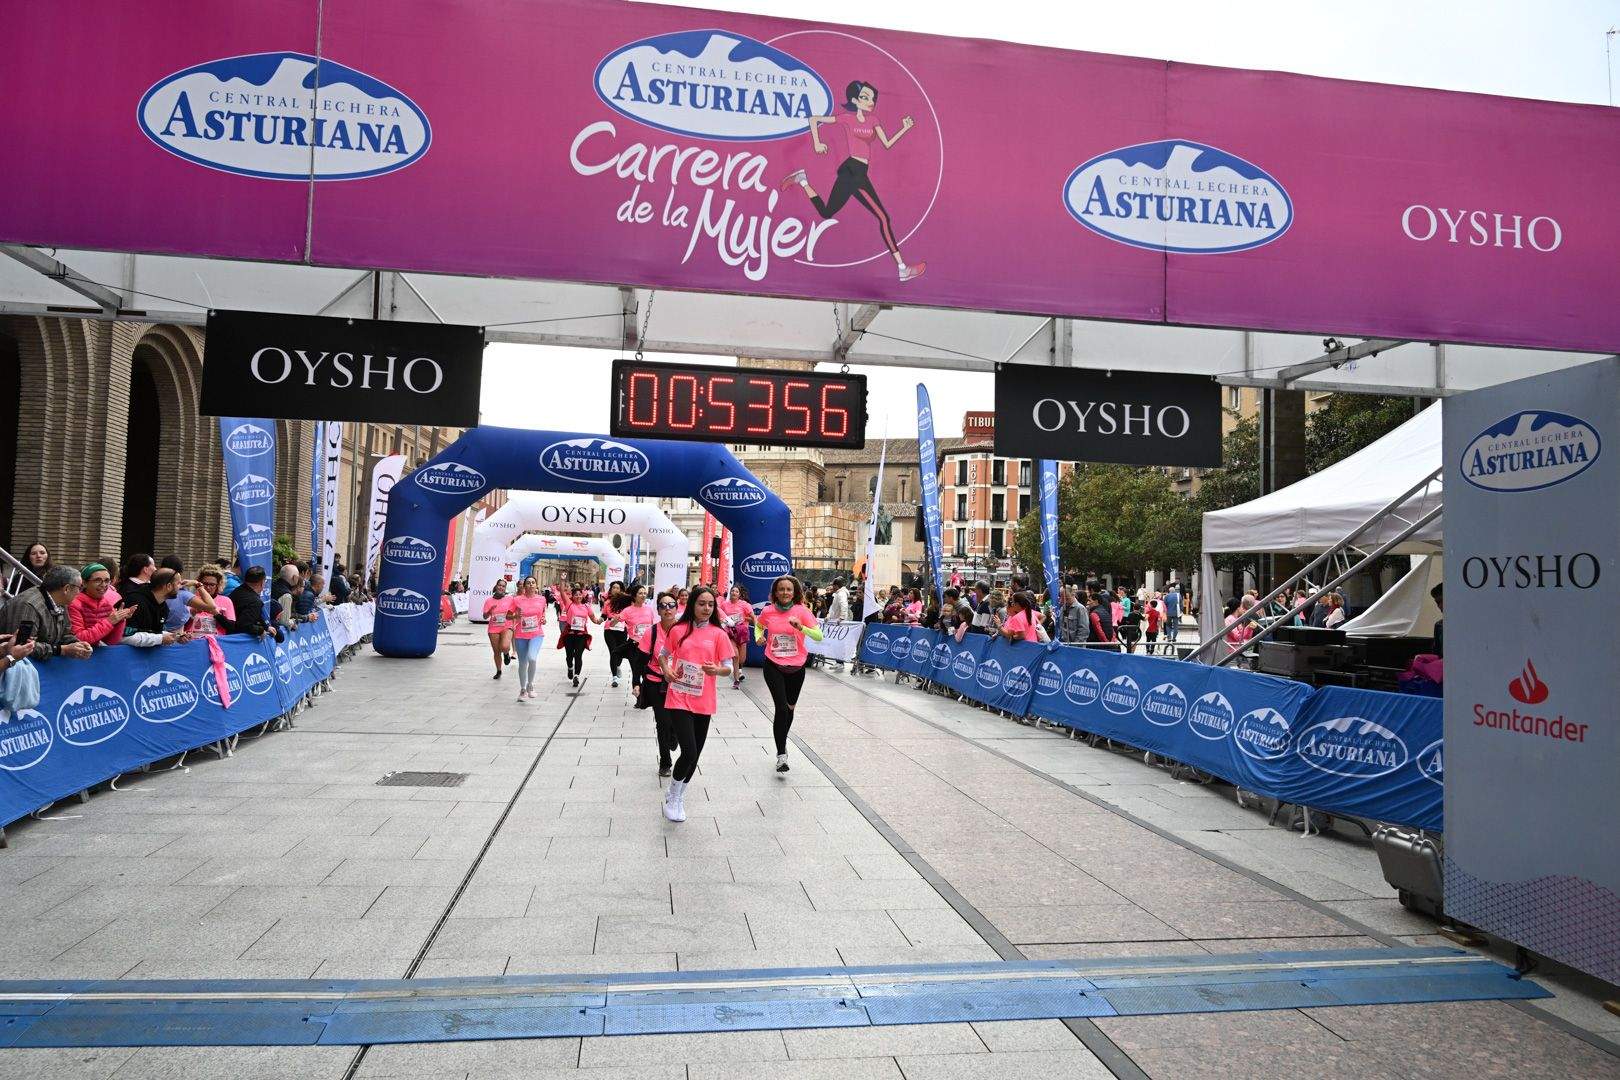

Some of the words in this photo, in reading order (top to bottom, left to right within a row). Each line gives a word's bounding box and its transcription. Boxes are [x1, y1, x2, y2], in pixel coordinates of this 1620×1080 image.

[652, 62, 727, 80] CENTRAL
[734, 71, 809, 88] LECHERA
[209, 90, 300, 110] CENTRAL
[309, 98, 401, 118] LECHERA
[613, 61, 813, 119] ASTURIANA
[160, 90, 409, 155] ASTURIANA
[569, 120, 769, 193] Carrera
[1118, 174, 1191, 190] CENTRAL
[1198, 181, 1269, 196] LECHERA
[1081, 174, 1276, 230] ASTURIANA
[616, 184, 655, 224] de
[662, 186, 690, 228] la
[681, 188, 840, 281] Mujer
[1401, 204, 1563, 252] OYSHO
[250, 346, 444, 394] OYSHO
[1032, 398, 1190, 439] OYSHO
[565, 449, 600, 457] CENTRAL
[603, 452, 639, 460] LECHERA
[1488, 438, 1530, 452] CENTRAL
[1534, 430, 1584, 445] LECHERA
[548, 449, 641, 474] ASTURIANA
[1469, 441, 1590, 478] ASTURIANA
[418, 471, 480, 488] ASTURIANA
[489, 521, 517, 530] OYSHO
[541, 504, 627, 526] OYSHO
[648, 527, 675, 535] OYSHO
[475, 555, 501, 563] OYSHO
[660, 562, 684, 570] OYSHO
[1462, 552, 1601, 590] OYSHO
[140, 689, 196, 715] ASTURIANA
[64, 706, 126, 737] ASTURIANA
[1472, 703, 1589, 743] Santander
[1302, 733, 1397, 768] ASTURIANA
